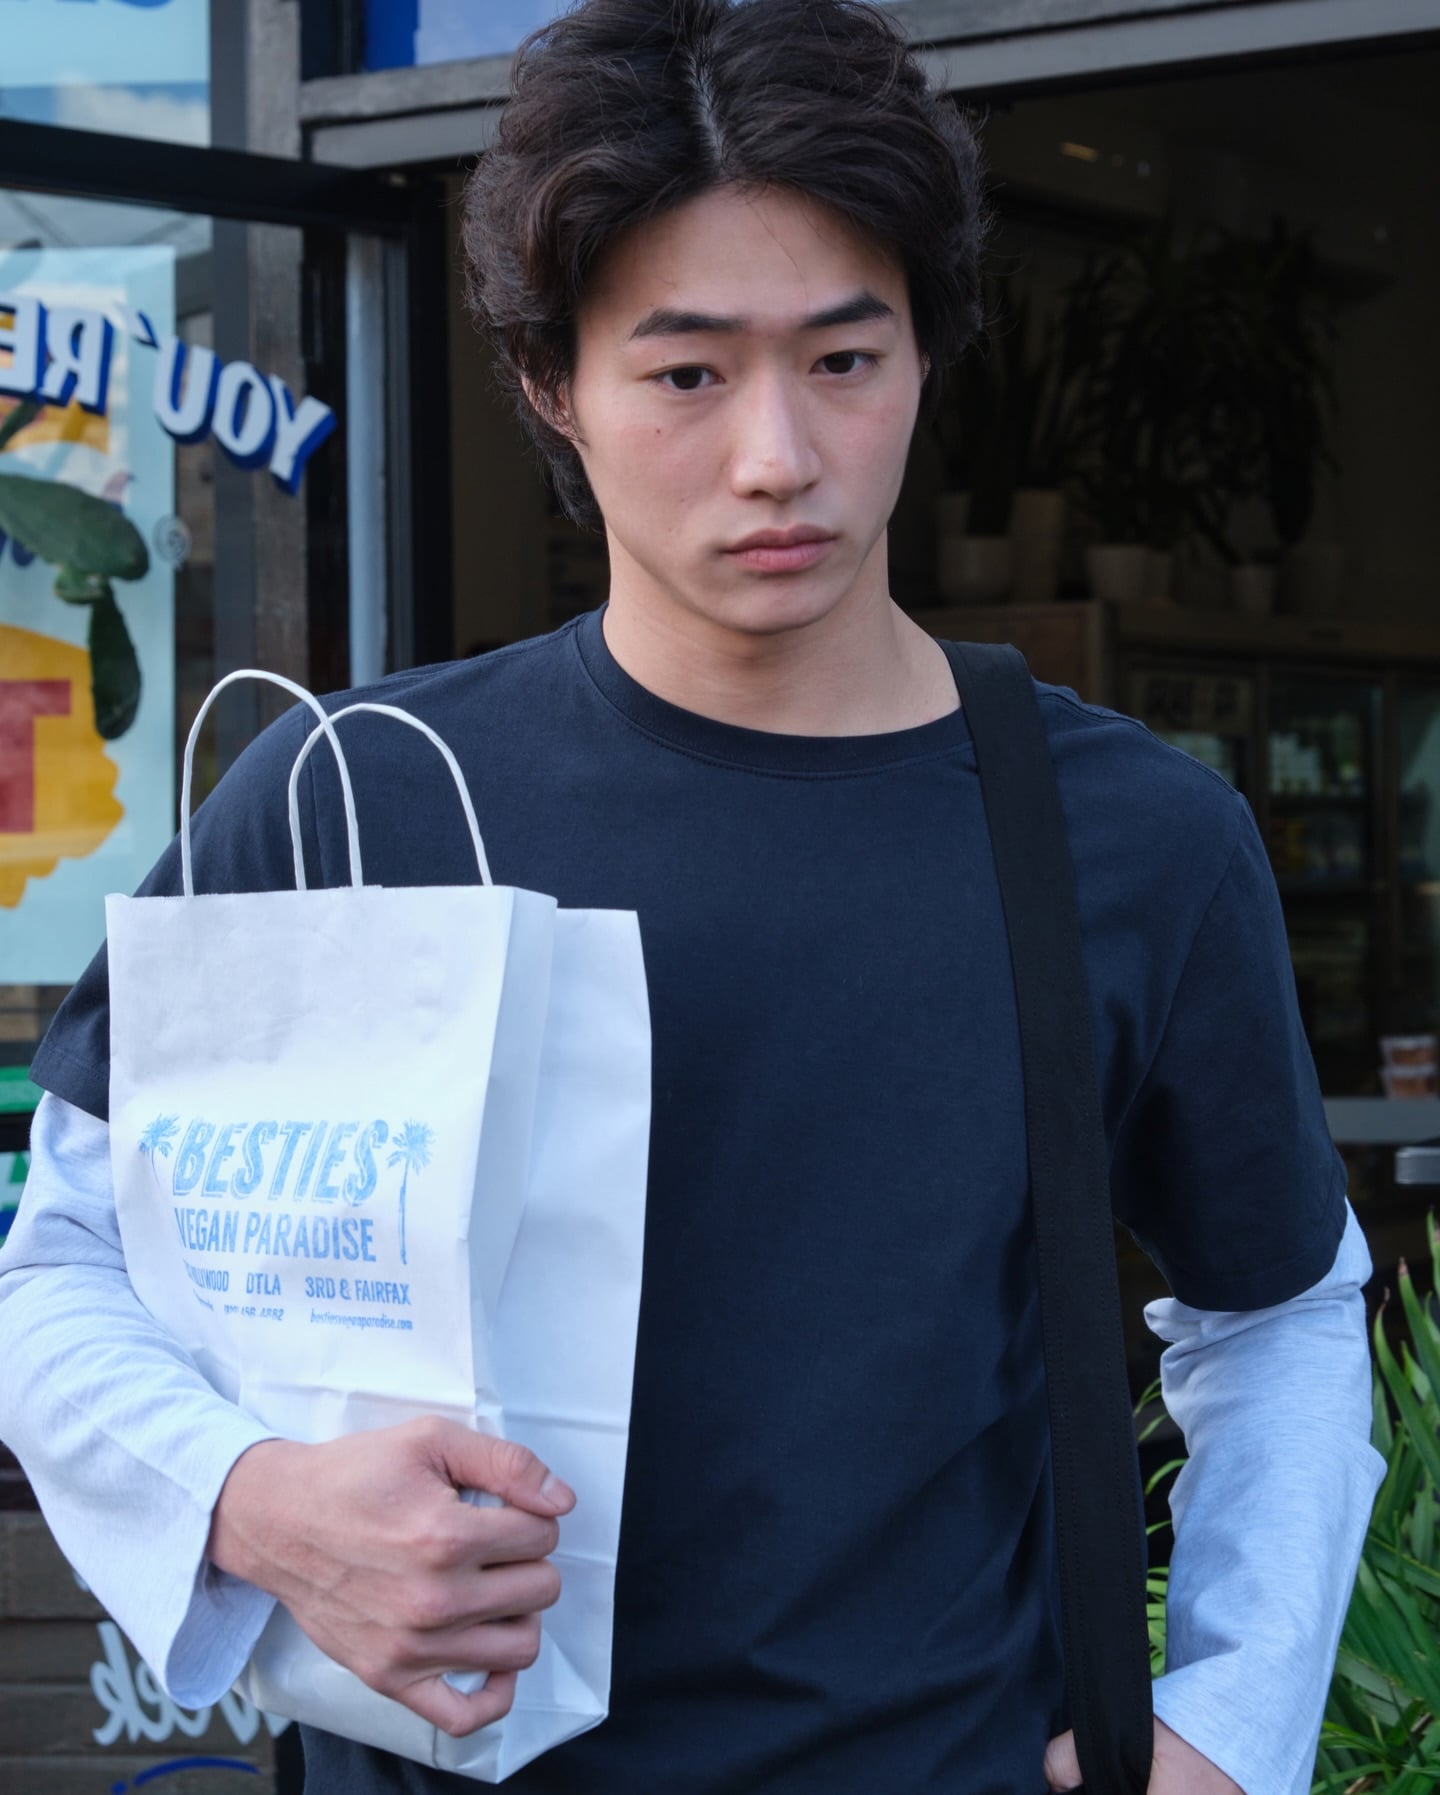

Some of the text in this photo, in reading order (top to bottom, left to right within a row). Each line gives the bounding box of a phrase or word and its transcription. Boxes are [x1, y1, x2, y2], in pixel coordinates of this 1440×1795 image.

[172, 1119, 390, 1207] BESTIES
[174, 1207, 377, 1262] VEGAN PARADISE
[246, 1272, 281, 1296] DTLA
[305, 1276, 336, 1299] 3RD
[339, 1279, 352, 1300] &
[355, 1279, 412, 1305] FAIRFAX
